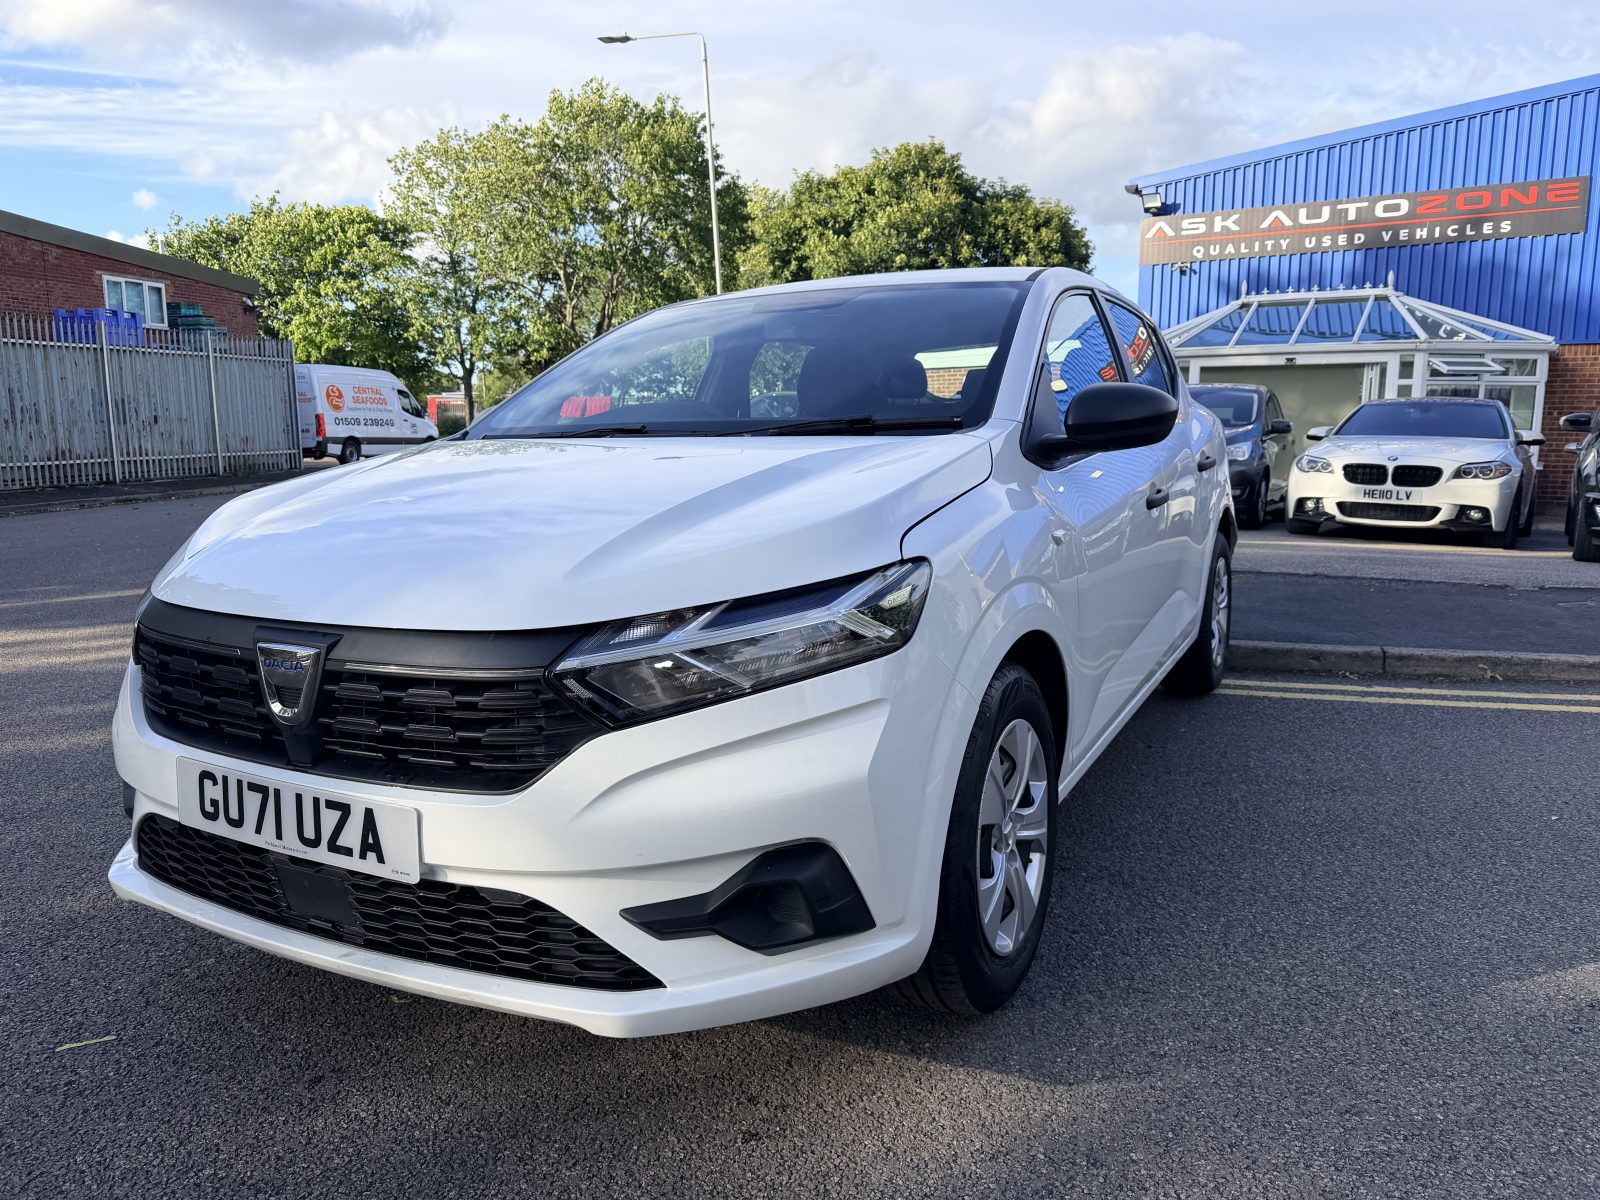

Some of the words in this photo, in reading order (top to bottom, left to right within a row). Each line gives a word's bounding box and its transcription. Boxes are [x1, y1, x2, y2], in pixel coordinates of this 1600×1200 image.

[1145, 214, 1241, 238] ASK
[1192, 238, 1291, 259] QUALITY
[1305, 232, 1366, 249] USED
[1381, 220, 1513, 242] VEHICLES
[352, 386, 384, 396] CENTRAL
[352, 396, 388, 406] SEAFOODS
[334, 417, 361, 426] 01509
[263, 656, 304, 672] DACIA
[198, 769, 283, 841] GU71
[295, 792, 386, 865] UZA
